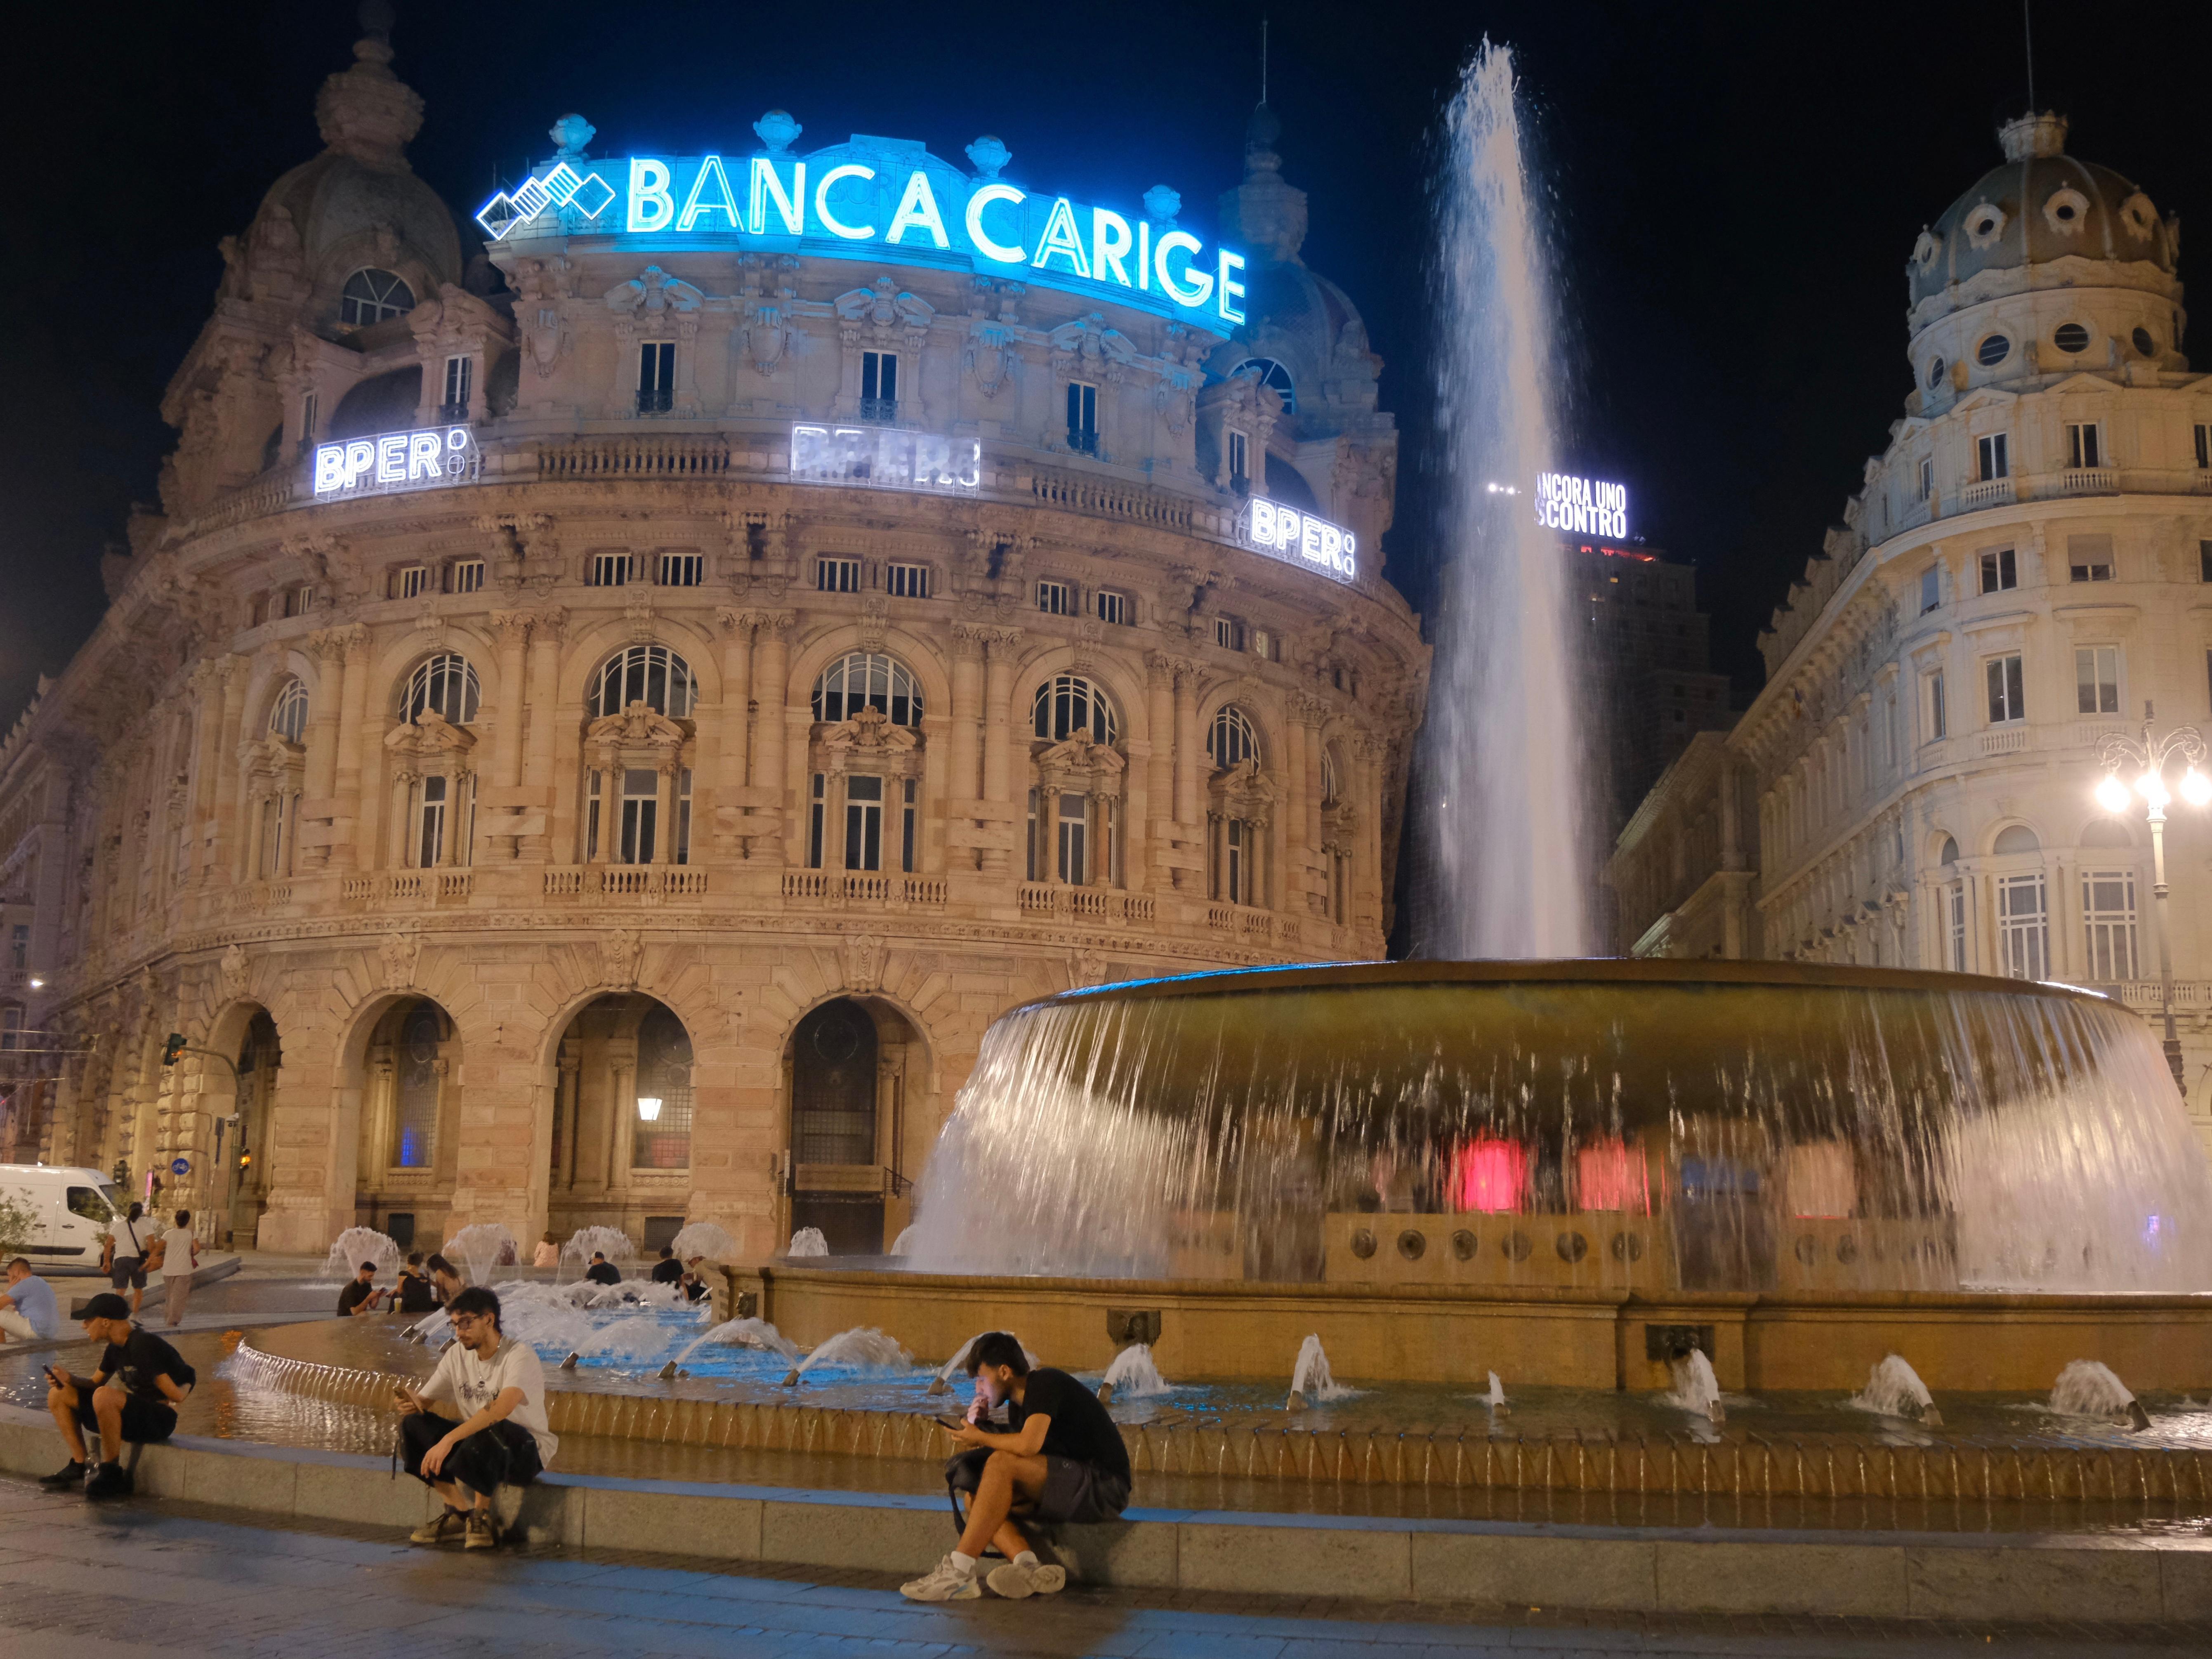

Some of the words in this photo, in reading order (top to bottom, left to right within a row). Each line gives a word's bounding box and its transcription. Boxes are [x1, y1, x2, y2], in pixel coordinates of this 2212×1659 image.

[627, 155, 951, 250] BANCA
[966, 184, 1245, 325] CARIGE
[1595, 481, 1626, 512] UNO
